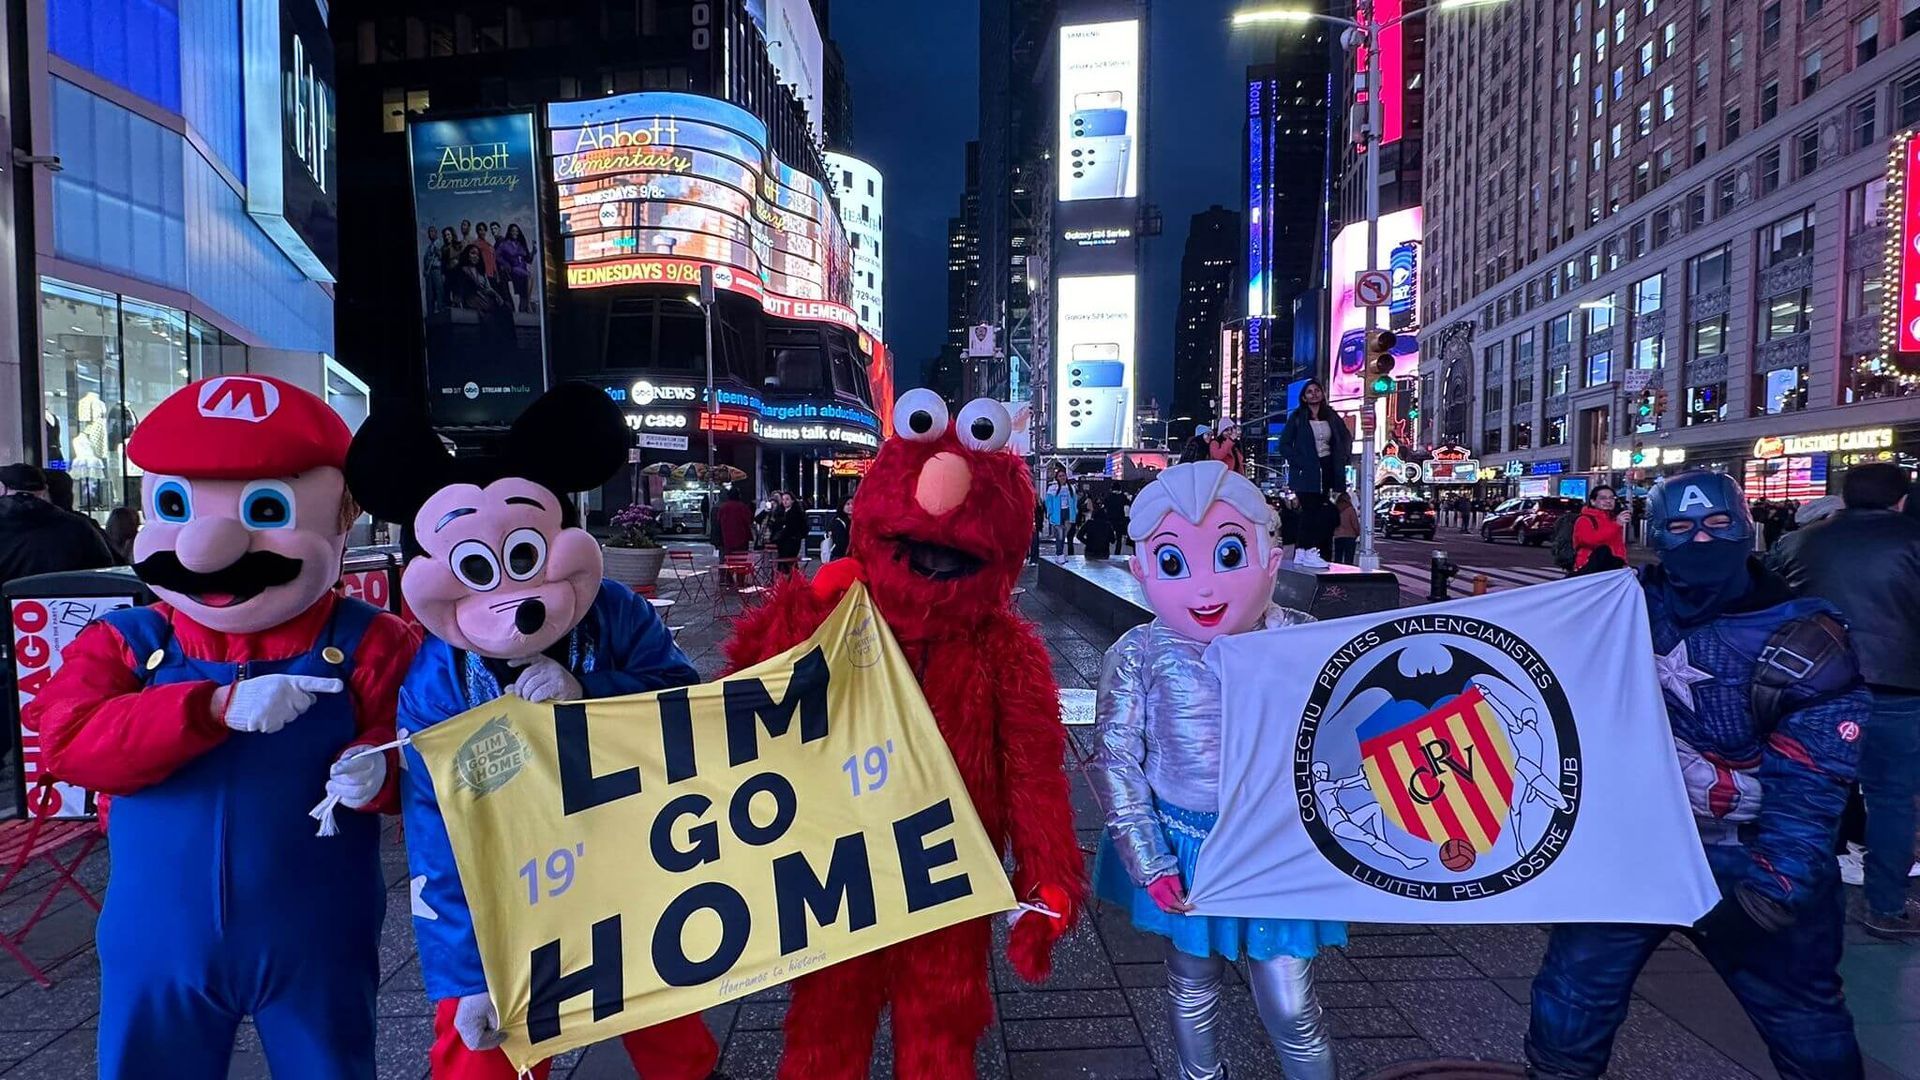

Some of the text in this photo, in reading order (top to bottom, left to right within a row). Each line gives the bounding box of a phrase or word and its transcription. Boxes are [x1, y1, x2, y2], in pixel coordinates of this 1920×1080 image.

[294, 33, 328, 195] GAP
[575, 113, 680, 154] Abbott
[438, 143, 509, 173] Abbott
[558, 147, 692, 178] Elementary
[427, 171, 520, 192] Elementary
[568, 262, 662, 285] WEDNESDAYS
[715, 270, 732, 281] abc
[202, 379, 268, 418] M
[654, 387, 696, 400] NEWS
[718, 389, 748, 405] teens
[645, 414, 686, 428] case
[700, 412, 749, 432] ESPN
[805, 404, 817, 416] in
[764, 425, 800, 440] slams
[801, 425, 828, 439] talk
[829, 428, 841, 441] of
[1784, 434, 1839, 454] RAISING
[1678, 485, 1713, 512] A
[1319, 631, 1381, 689] PENYES
[1394, 617, 1553, 690] VALENCIANISTES
[552, 643, 830, 816] LIM
[475, 734, 502, 755] LIM
[468, 755, 487, 770] GO
[475, 752, 522, 782] HOME
[649, 771, 798, 873] GO
[1351, 757, 1578, 900] LLUITEM PEL NOSTRE CLUB
[527, 797, 973, 1045] HOME
